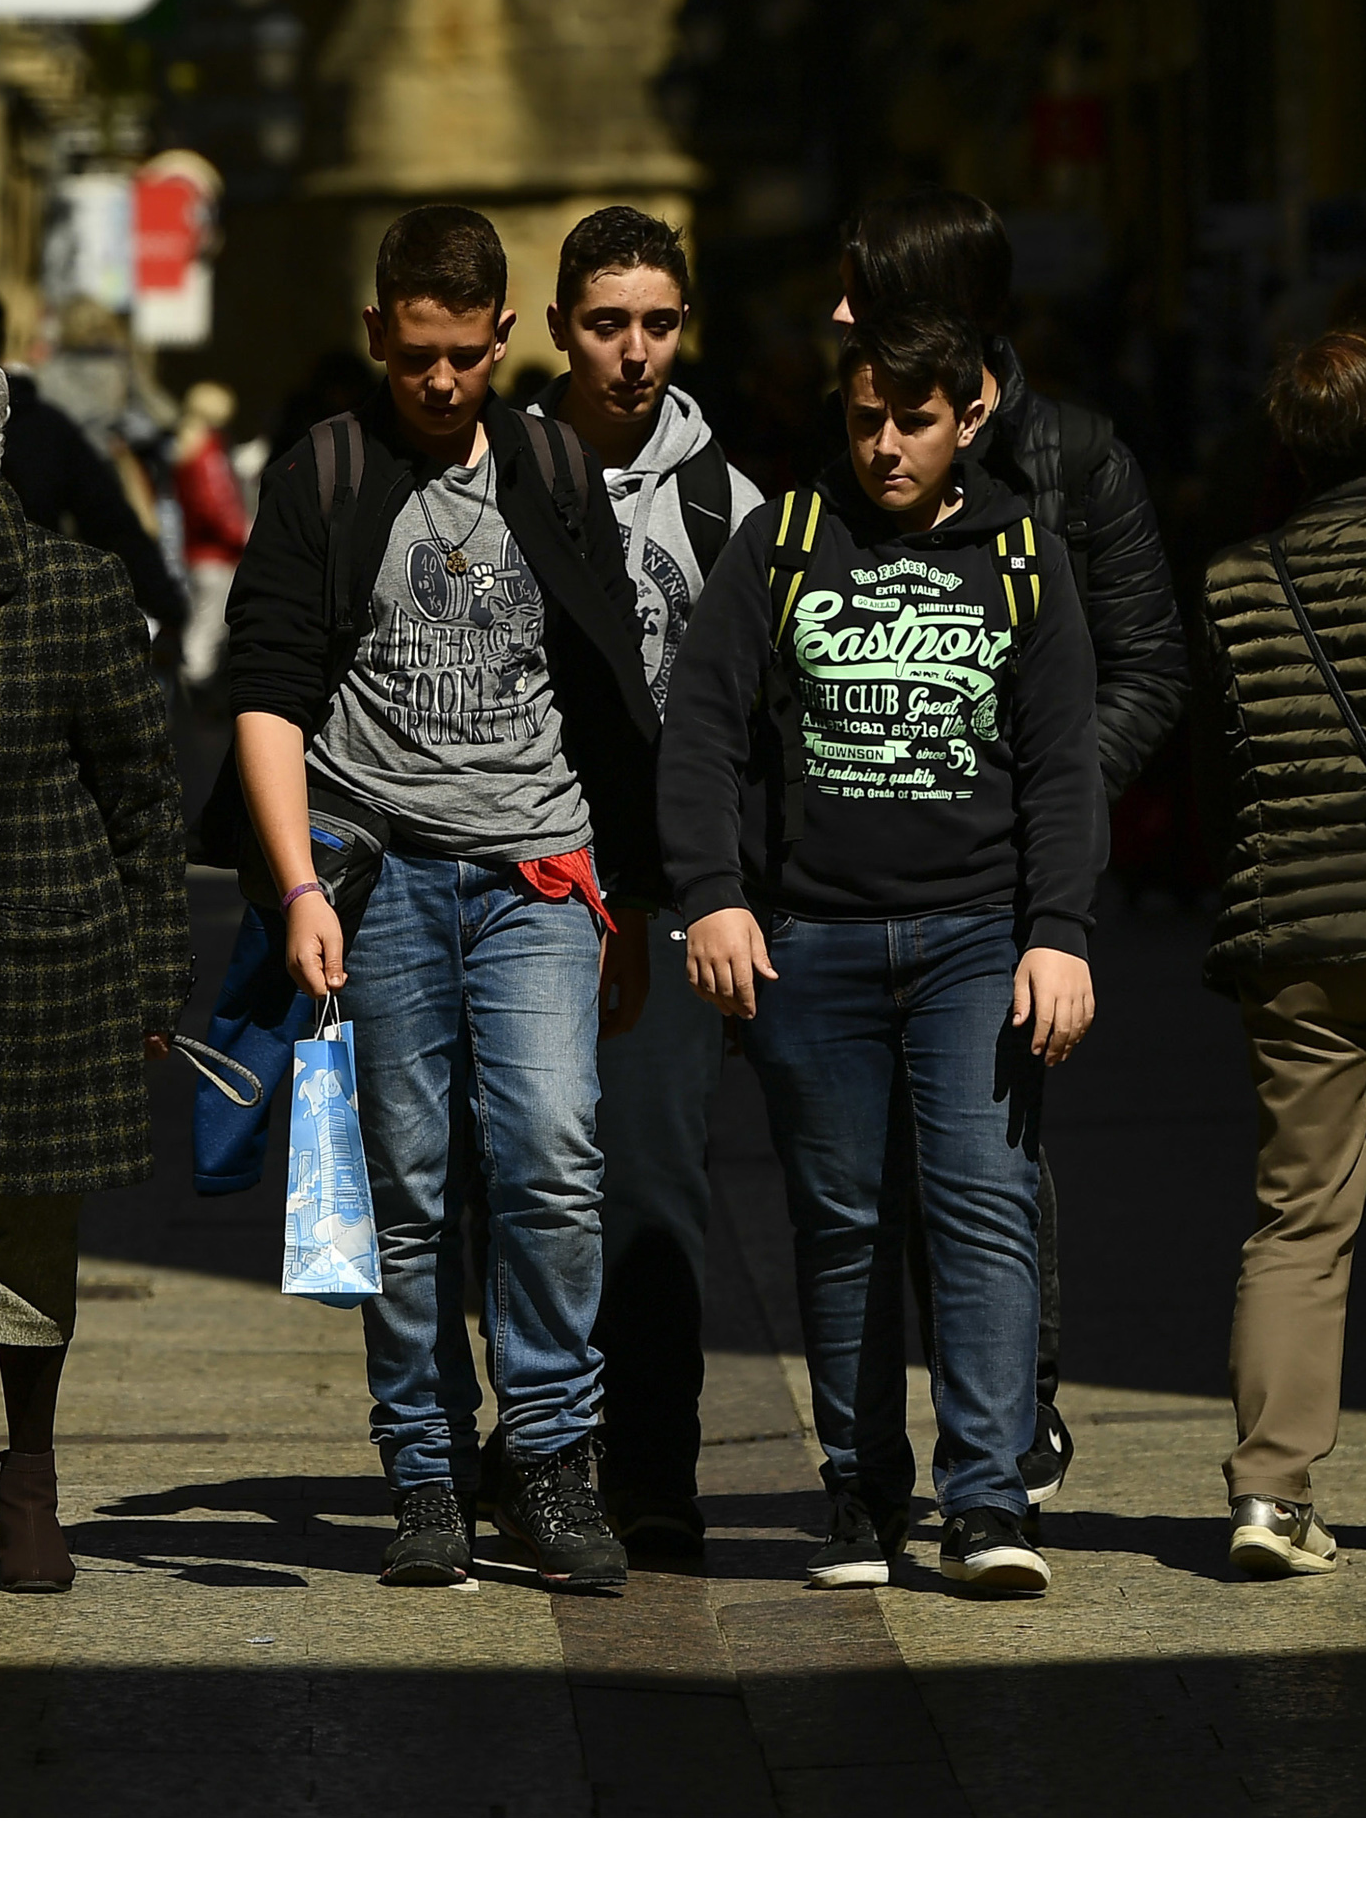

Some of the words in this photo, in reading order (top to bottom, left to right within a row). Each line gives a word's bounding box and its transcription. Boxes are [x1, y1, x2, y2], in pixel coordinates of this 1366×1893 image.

[851, 570, 877, 585] The
[878, 558, 927, 581] Fastest
[928, 567, 963, 591] Only
[858, 598, 867, 606] GO
[876, 585, 906, 596] EXTRA
[910, 584, 940, 597] VALUE
[955, 604, 984, 615] STYLED
[794, 590, 1012, 677] Eastport
[383, 665, 483, 714] ROOM
[845, 684, 900, 715] CLUB
[904, 687, 963, 722] Great
[801, 711, 886, 736] American
[891, 721, 939, 740] style
[821, 744, 884, 760] TOWNSON
